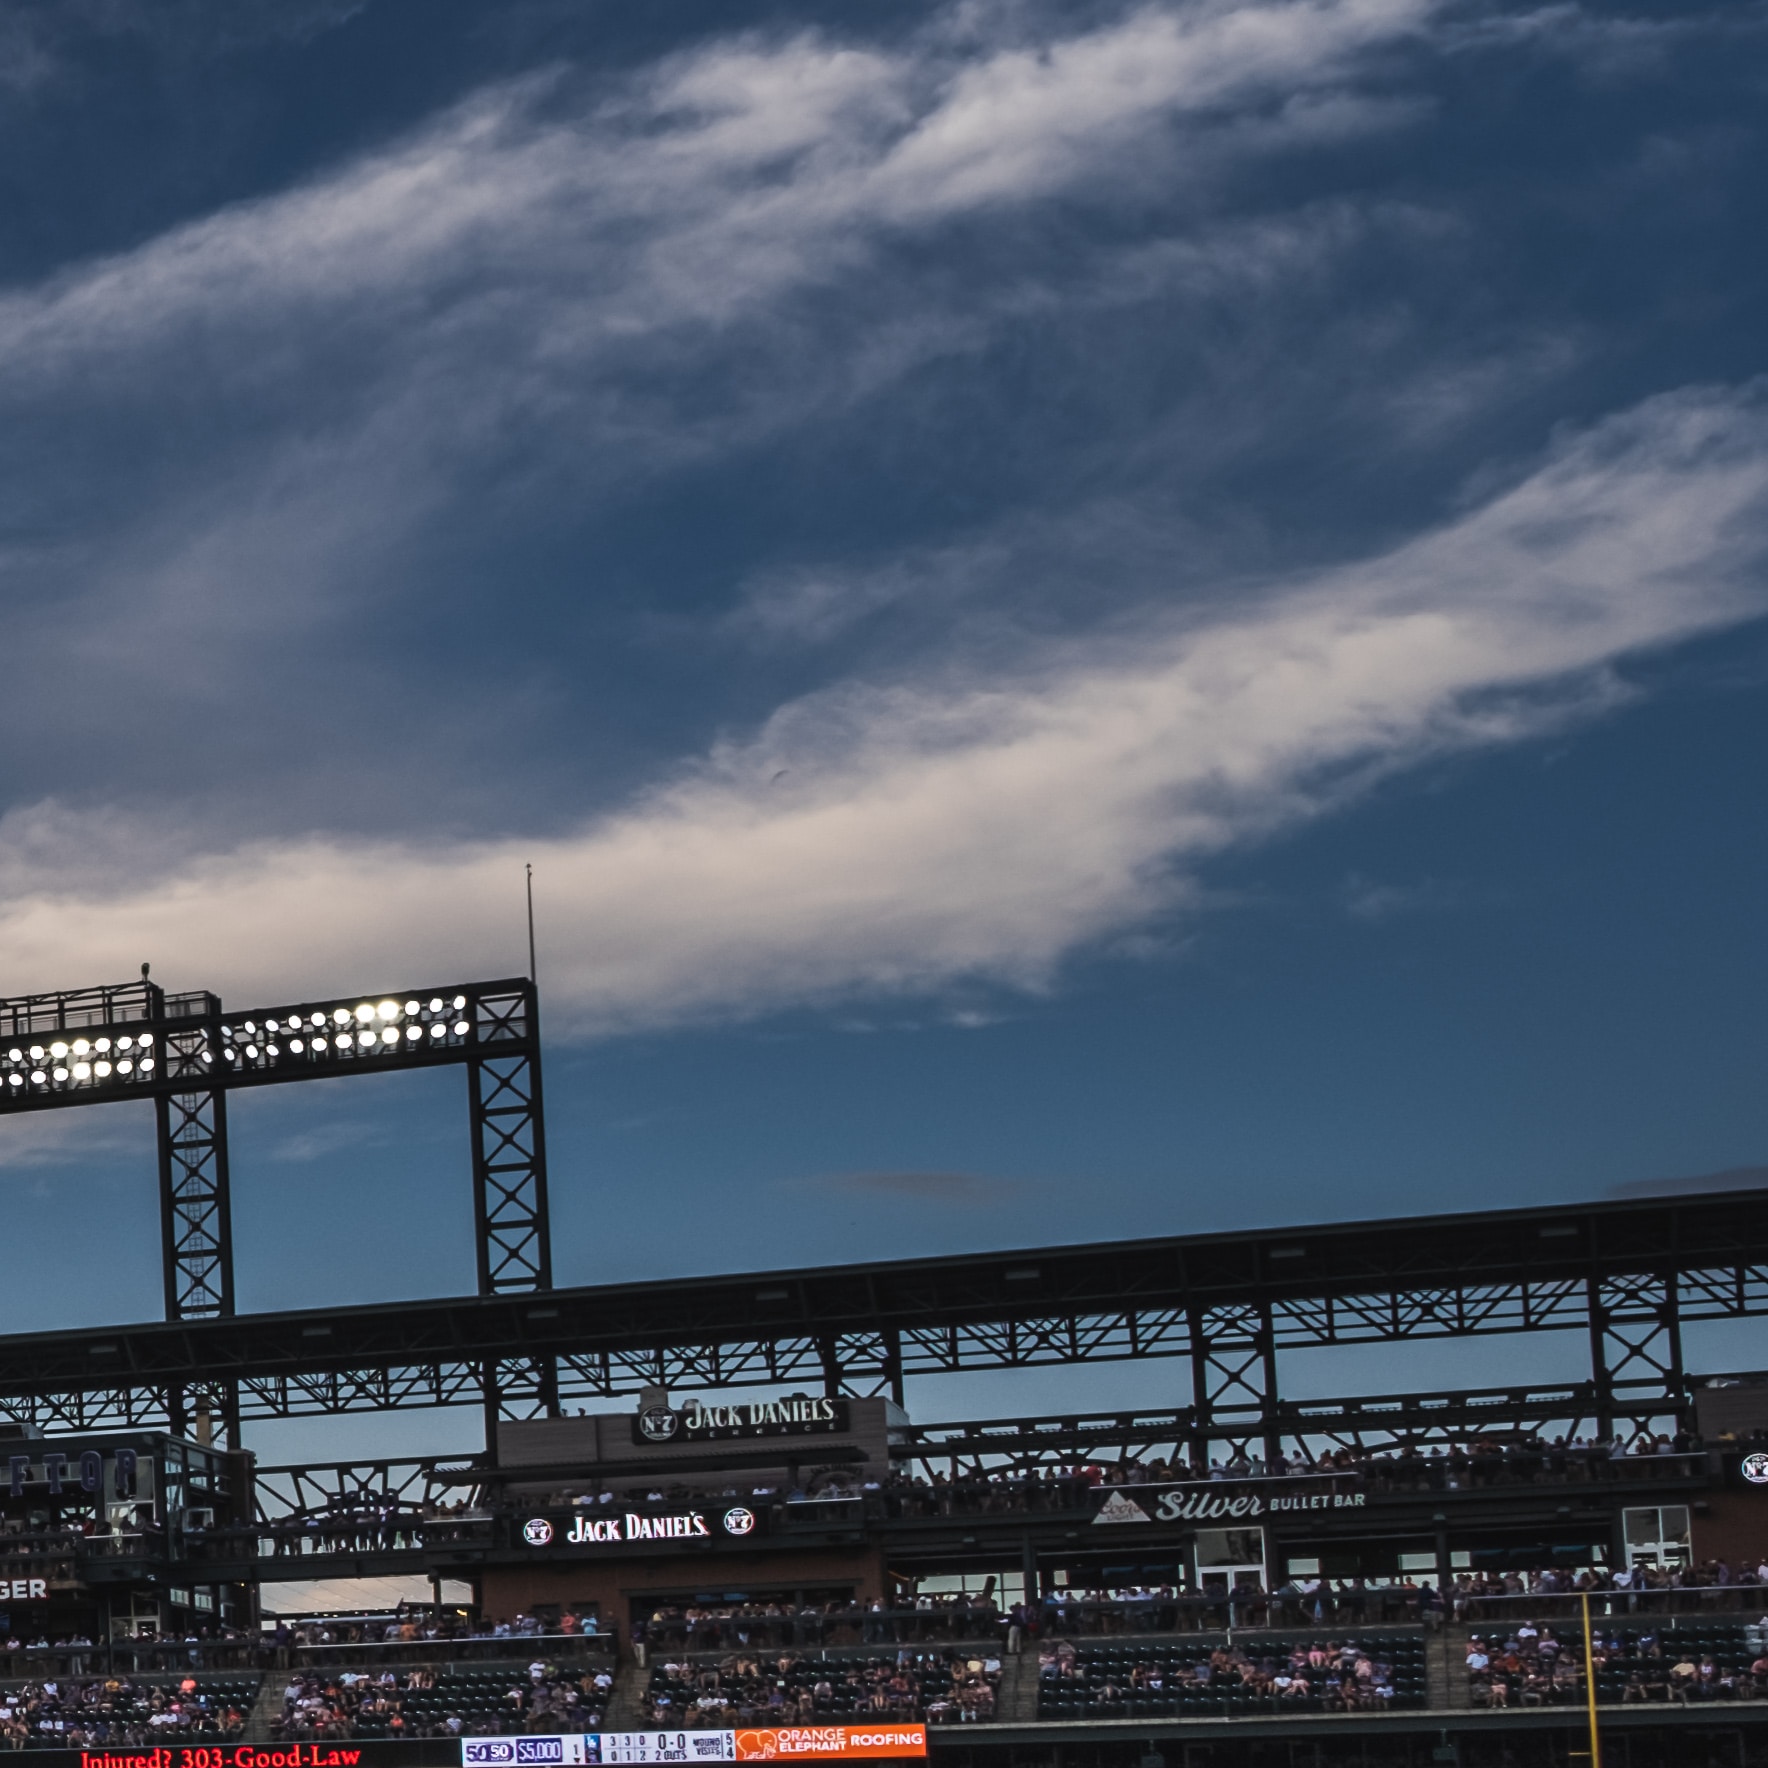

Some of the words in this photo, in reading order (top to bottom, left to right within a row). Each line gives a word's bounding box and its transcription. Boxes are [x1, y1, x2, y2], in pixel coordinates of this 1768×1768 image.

[686, 1402, 742, 1428] JACK
[750, 1398, 834, 1424] DANIEL'S
[1155, 1491, 1265, 1521] Silver
[1270, 1496, 1329, 1511] BULLET
[1334, 1494, 1366, 1508] BAR
[568, 1516, 622, 1542] JACK
[627, 1511, 711, 1539] DANIEL'S
[778, 1729, 845, 1742] ORANGE
[778, 1741, 846, 1752] ELEPHANT
[850, 1733, 923, 1747] ROOFING
